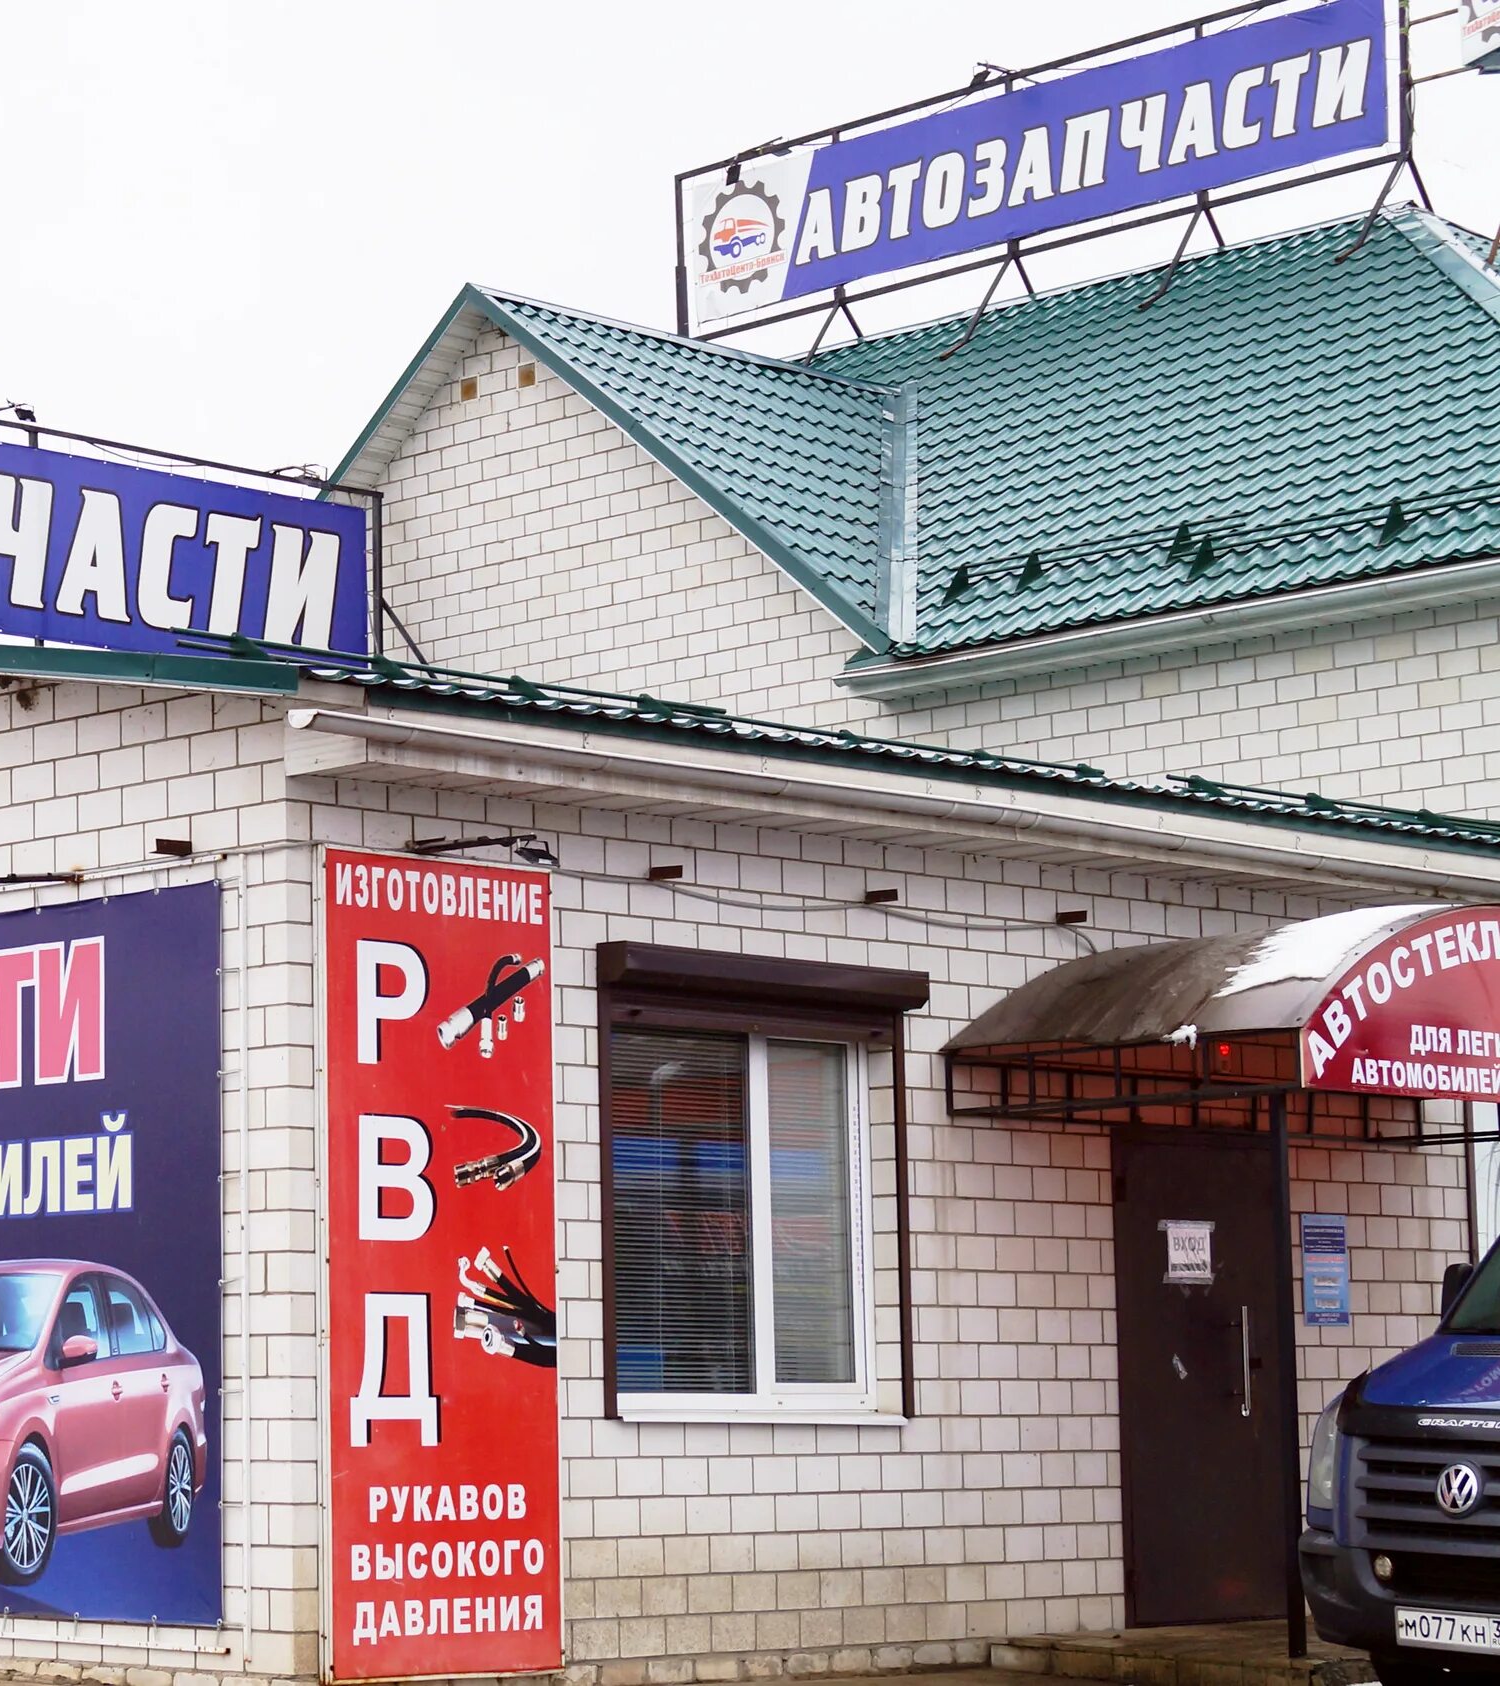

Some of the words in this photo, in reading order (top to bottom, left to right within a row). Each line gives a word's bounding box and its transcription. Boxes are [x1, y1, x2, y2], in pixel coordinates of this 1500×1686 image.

[795, 37, 1372, 266] АВТОЗАПЧАСТИ
[335, 862, 543, 925] ИЗГОТОВЛЕНИЕ
[1410, 1024, 1451, 1056] ДЛЯ
[368, 1483, 527, 1523] РУКАВОВ
[350, 1538, 545, 1581] ВЫСОКОГО
[352, 1594, 543, 1647] ДАВЛЕНИЯ
